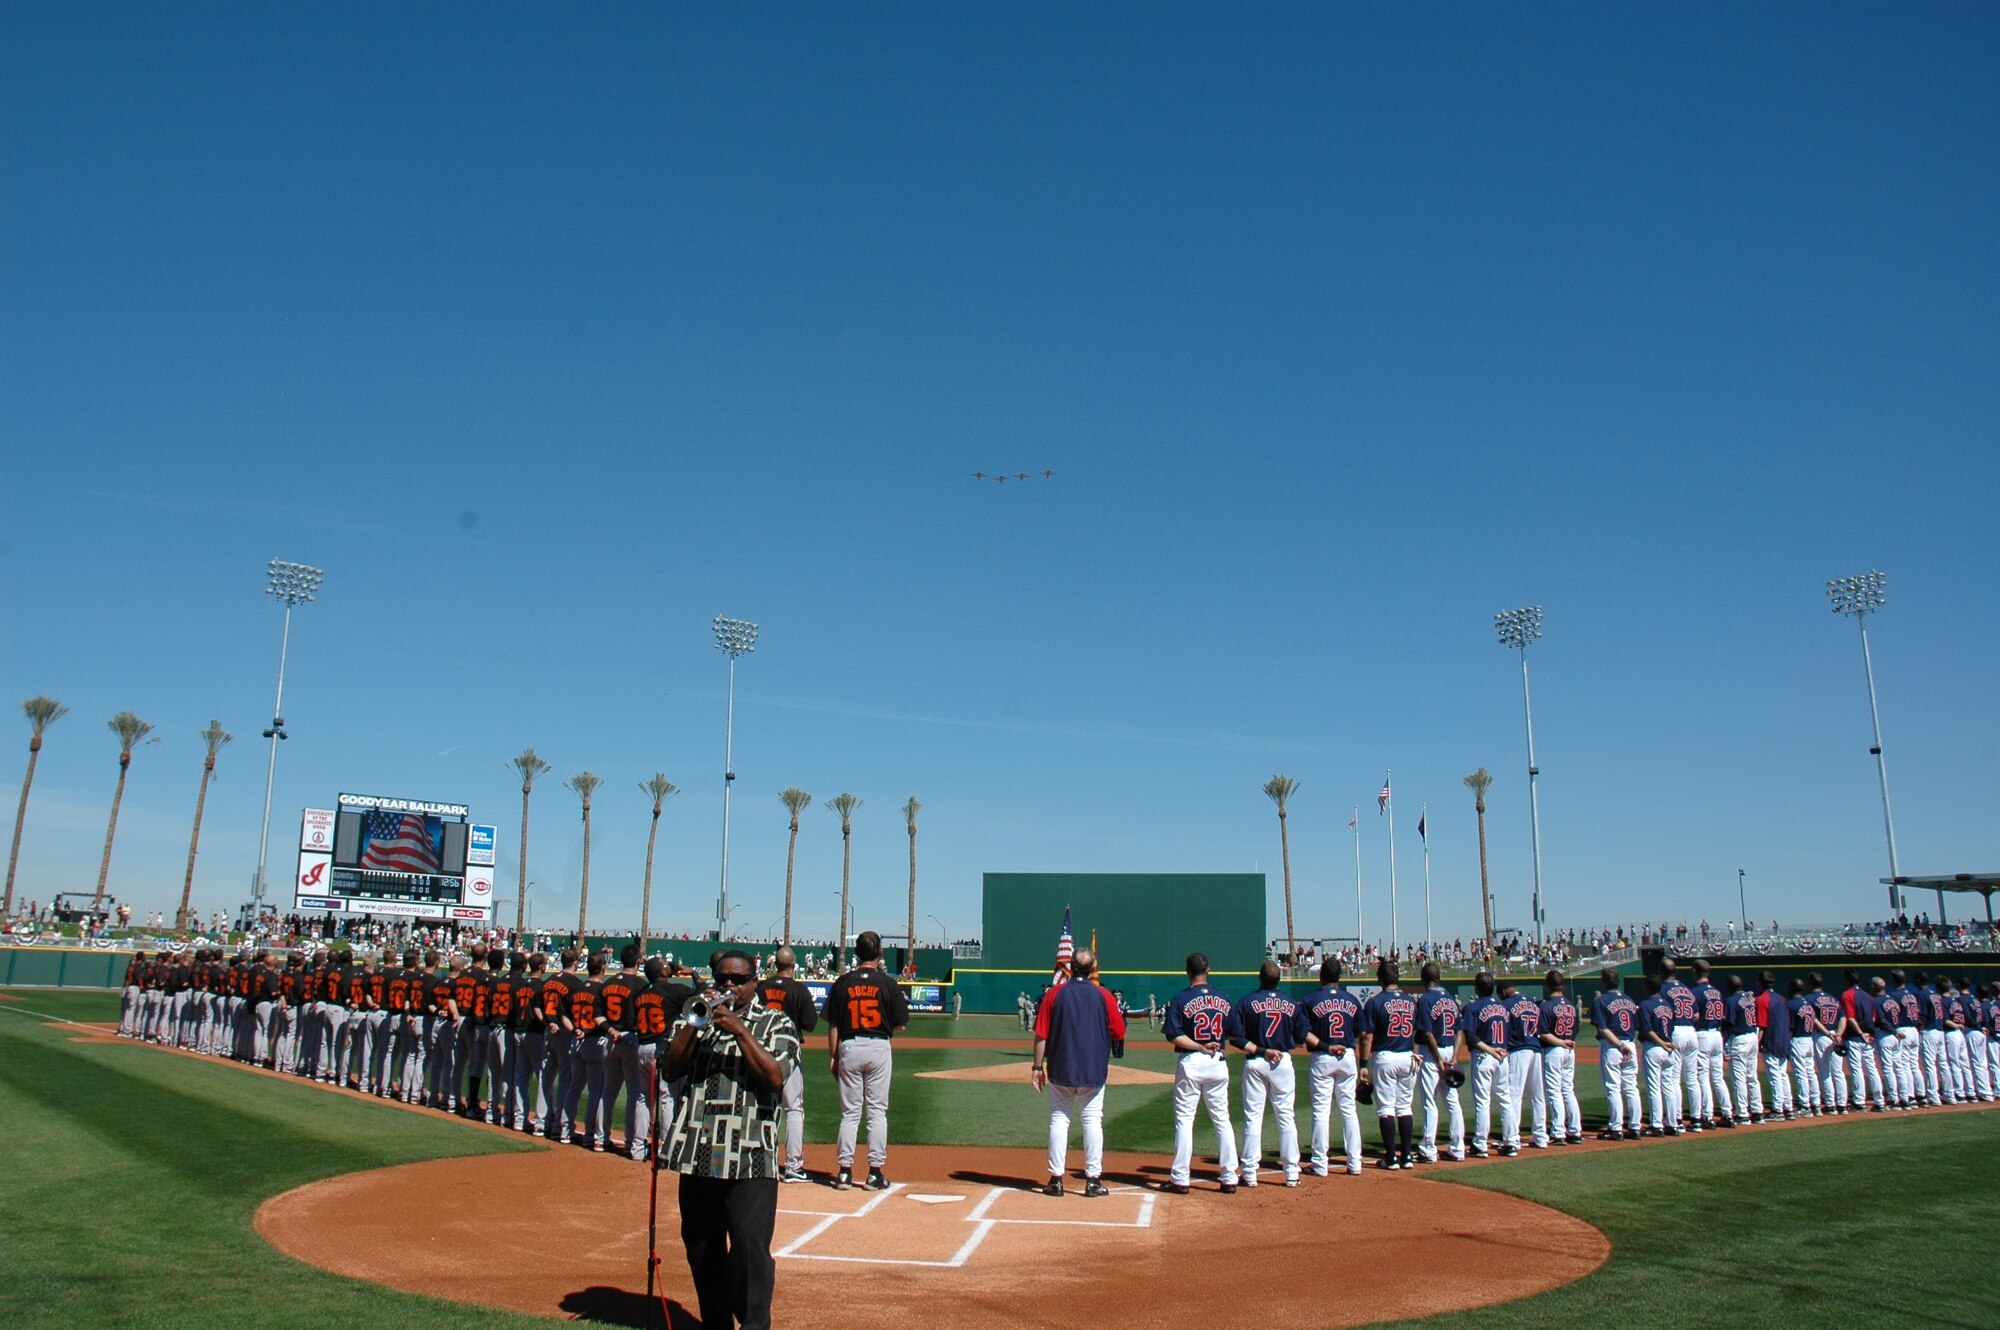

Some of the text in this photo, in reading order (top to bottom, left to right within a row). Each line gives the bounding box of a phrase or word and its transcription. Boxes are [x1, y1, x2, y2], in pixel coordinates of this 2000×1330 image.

[340, 795, 468, 815] GOODYEAR BALLPARK
[358, 903, 436, 914] www.goodyearaz.gov
[847, 985, 880, 998] BOCHY
[847, 999, 881, 1029] 15
[1183, 996, 1231, 1018] SIZEMORE
[1312, 998, 1358, 1017] PERALTA
[1673, 998, 1694, 1019] 35
[1705, 1001, 1724, 1020] 28
[1820, 1006, 1838, 1025] 87
[1194, 1012, 1223, 1040] 24
[1265, 1010, 1282, 1037] 7
[1329, 1012, 1345, 1038] 2
[1387, 1012, 1413, 1037] 25
[1520, 1014, 1539, 1037] 77
[1554, 1014, 1575, 1036] 62
[1618, 1009, 1631, 1031] 9
[1491, 1020, 1504, 1044] 11
